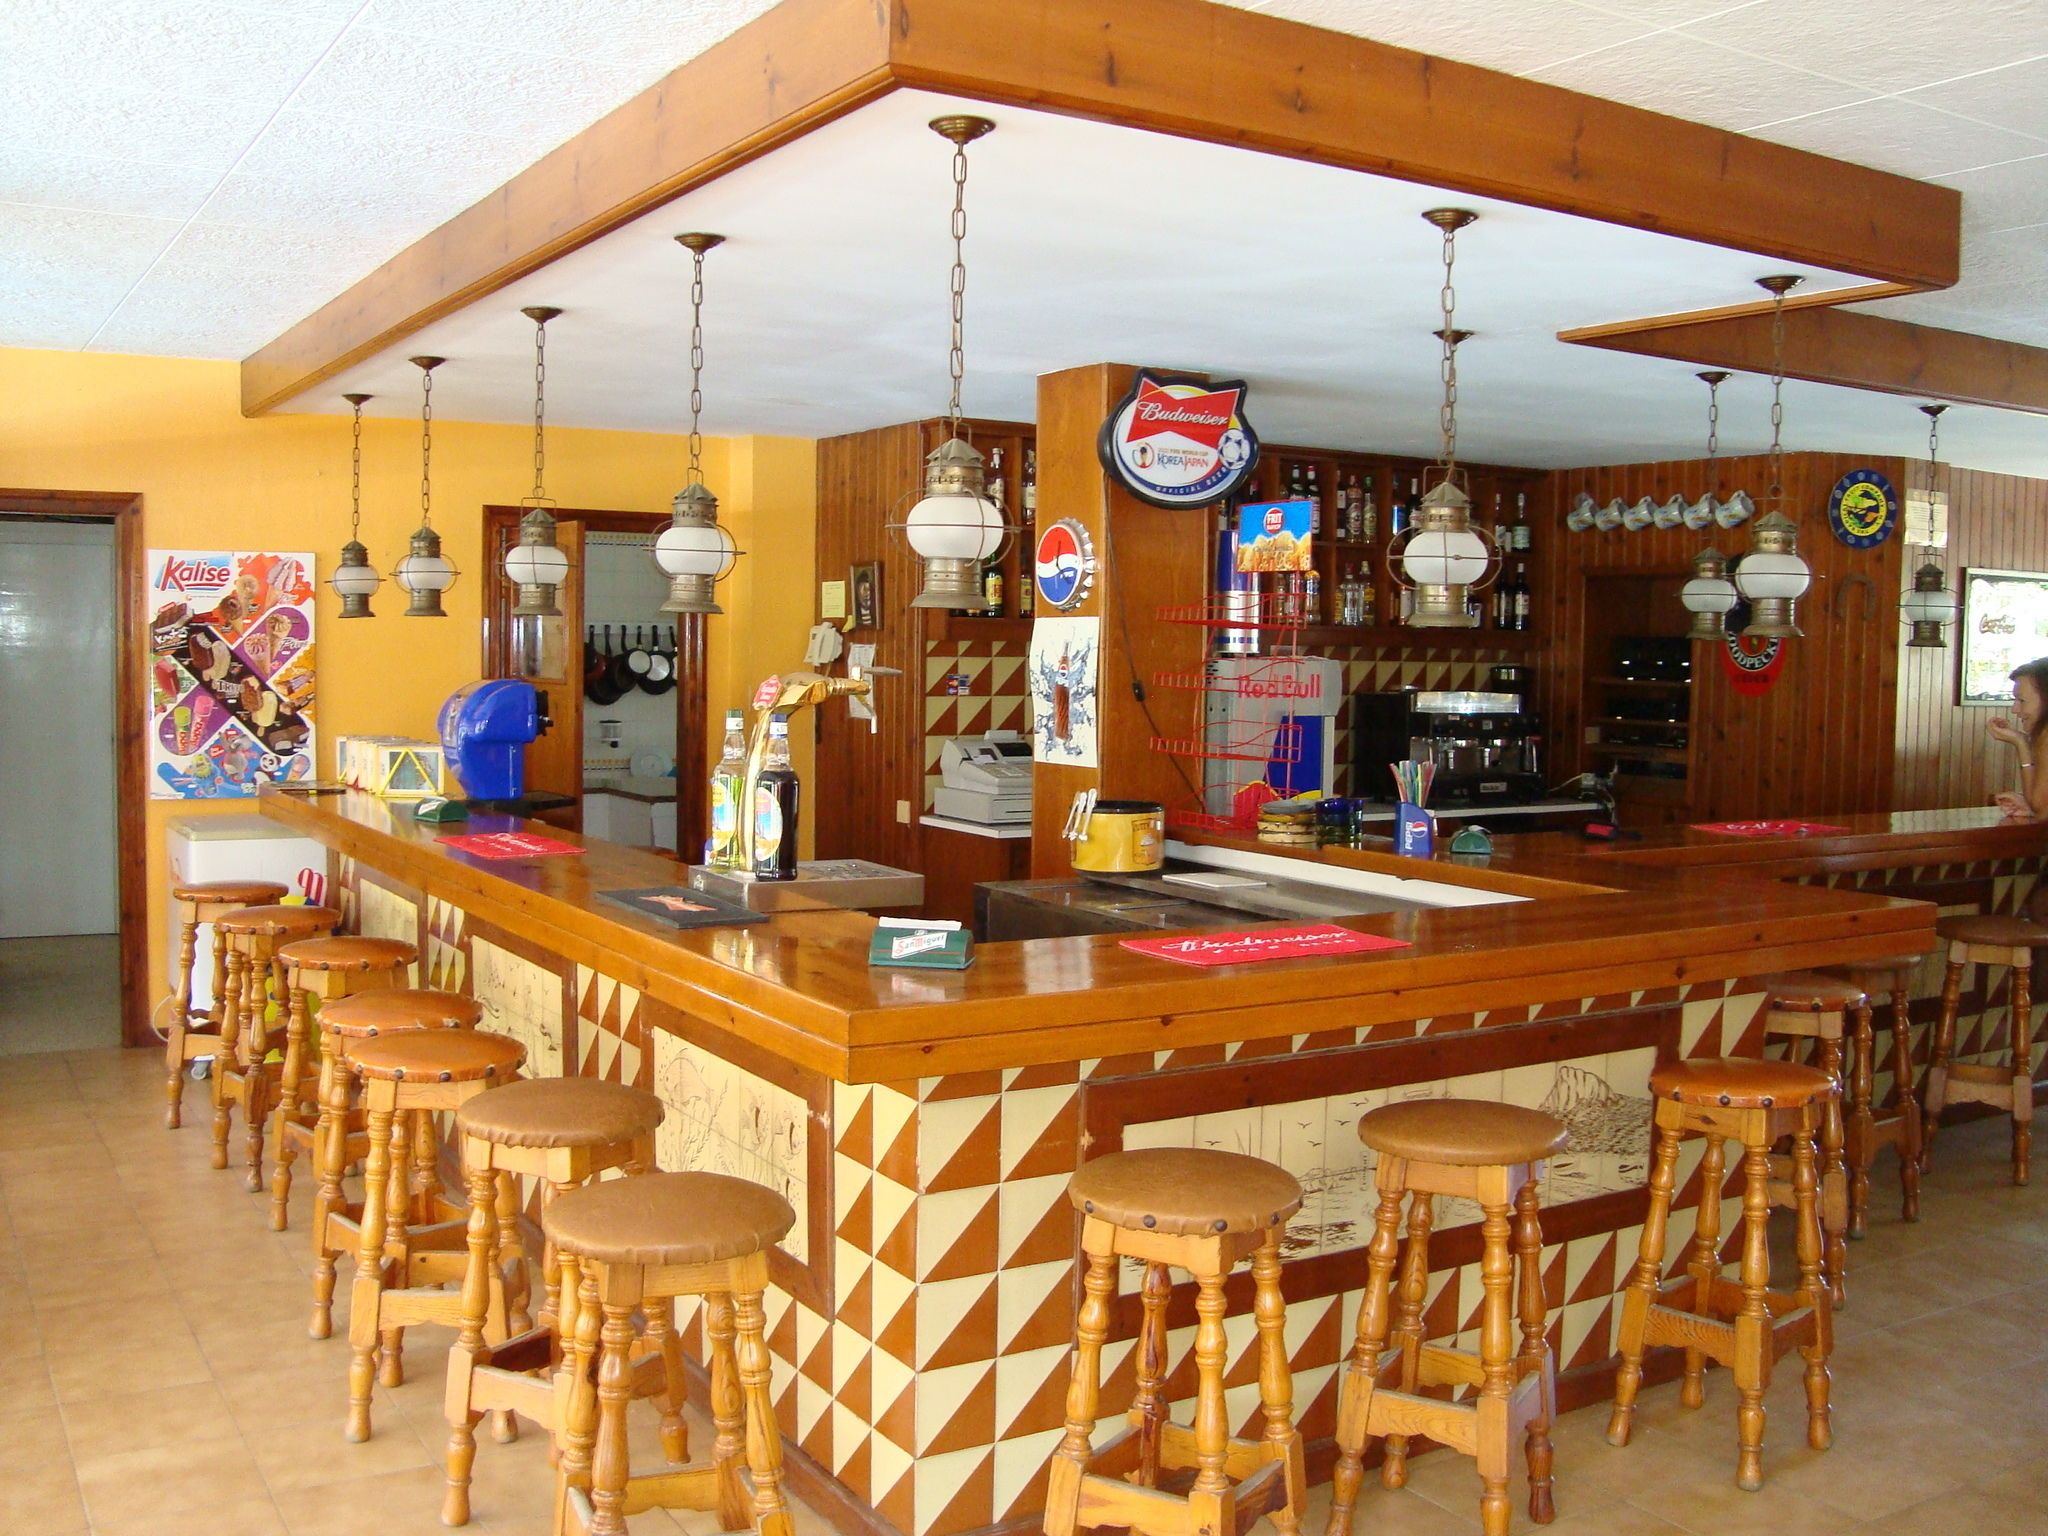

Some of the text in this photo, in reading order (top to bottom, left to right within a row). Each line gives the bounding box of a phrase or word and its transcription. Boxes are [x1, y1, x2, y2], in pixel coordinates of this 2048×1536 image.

[1138, 402, 1228, 425] Budweiser
[1184, 455, 1209, 471] JAPAN
[1267, 512, 1283, 523] FRIT
[160, 555, 231, 592] Kalise
[1238, 674, 1320, 699] Red Bull
[914, 933, 945, 948] Miguel
[1161, 930, 1349, 953] Budweiser
